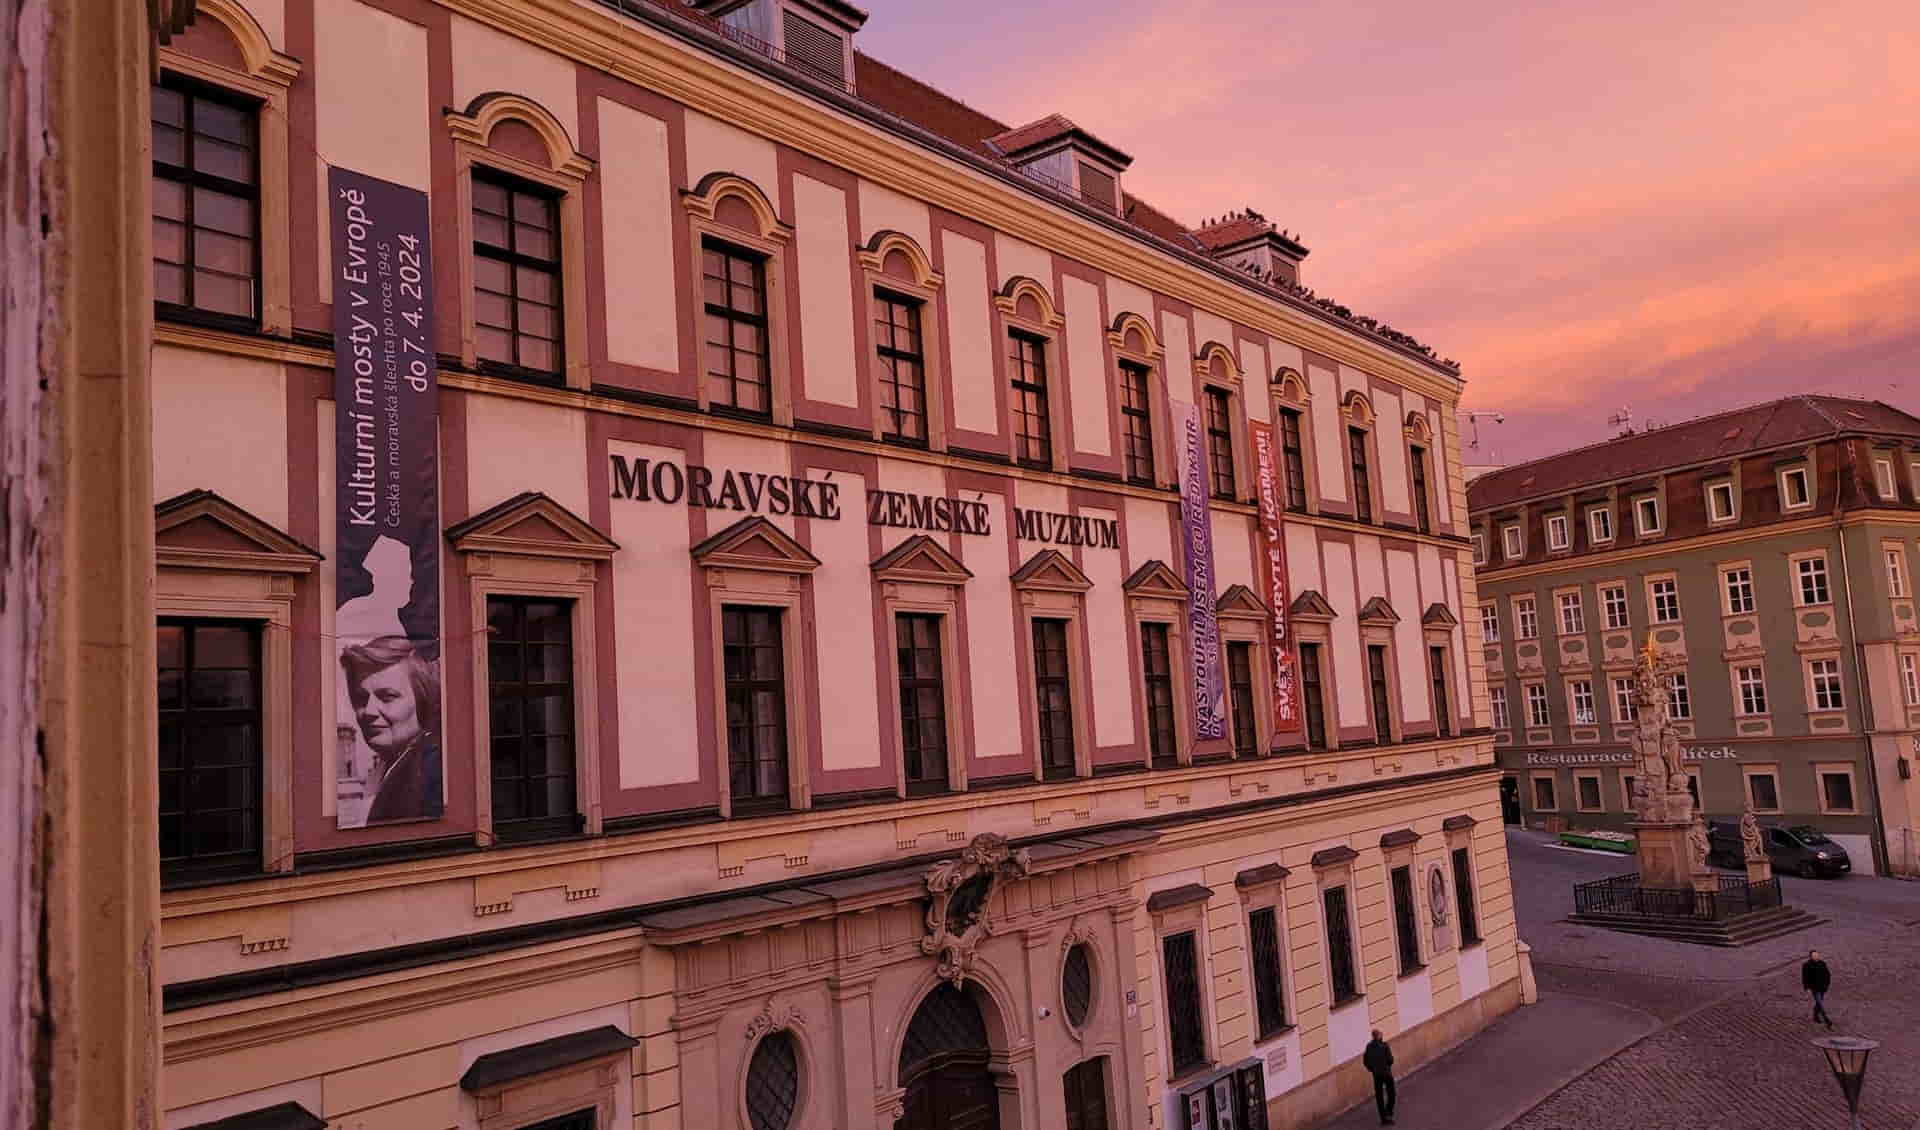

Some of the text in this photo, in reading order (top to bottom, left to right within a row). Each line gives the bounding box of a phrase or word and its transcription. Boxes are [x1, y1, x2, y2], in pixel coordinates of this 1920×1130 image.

[339, 188, 378, 525] Kulturní mosty v Evropě
[377, 241, 401, 528] Česká a moravská šlechta po roce 1945
[398, 233, 428, 392] do 7. 4. 2024
[610, 455, 1120, 549] MORAVSKÉ ZEMSKÉ MUZEUM
[1527, 752, 1633, 765] Restaurace
